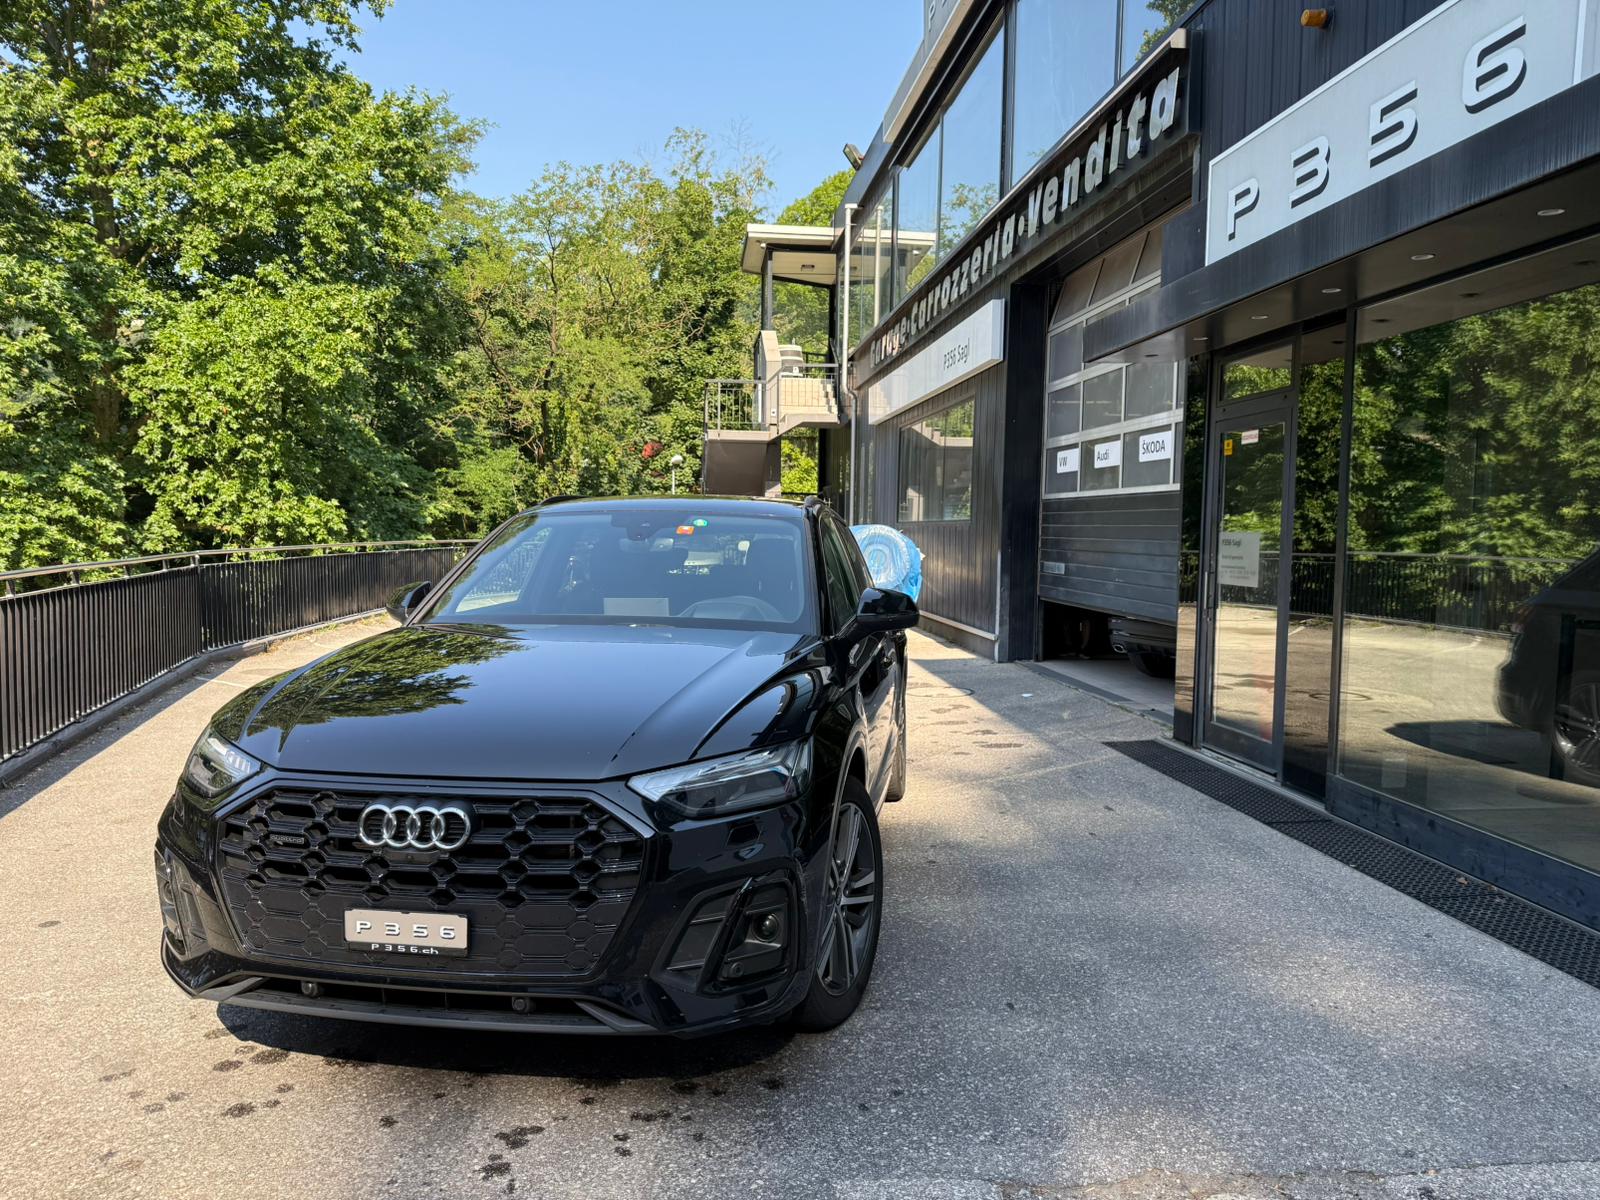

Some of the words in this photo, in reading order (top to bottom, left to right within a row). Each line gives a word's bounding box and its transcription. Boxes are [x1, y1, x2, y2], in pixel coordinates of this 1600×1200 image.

[957, 337, 970, 363] Sagl
[1059, 456, 1068, 468] VW
[1096, 448, 1110, 462] Audi
